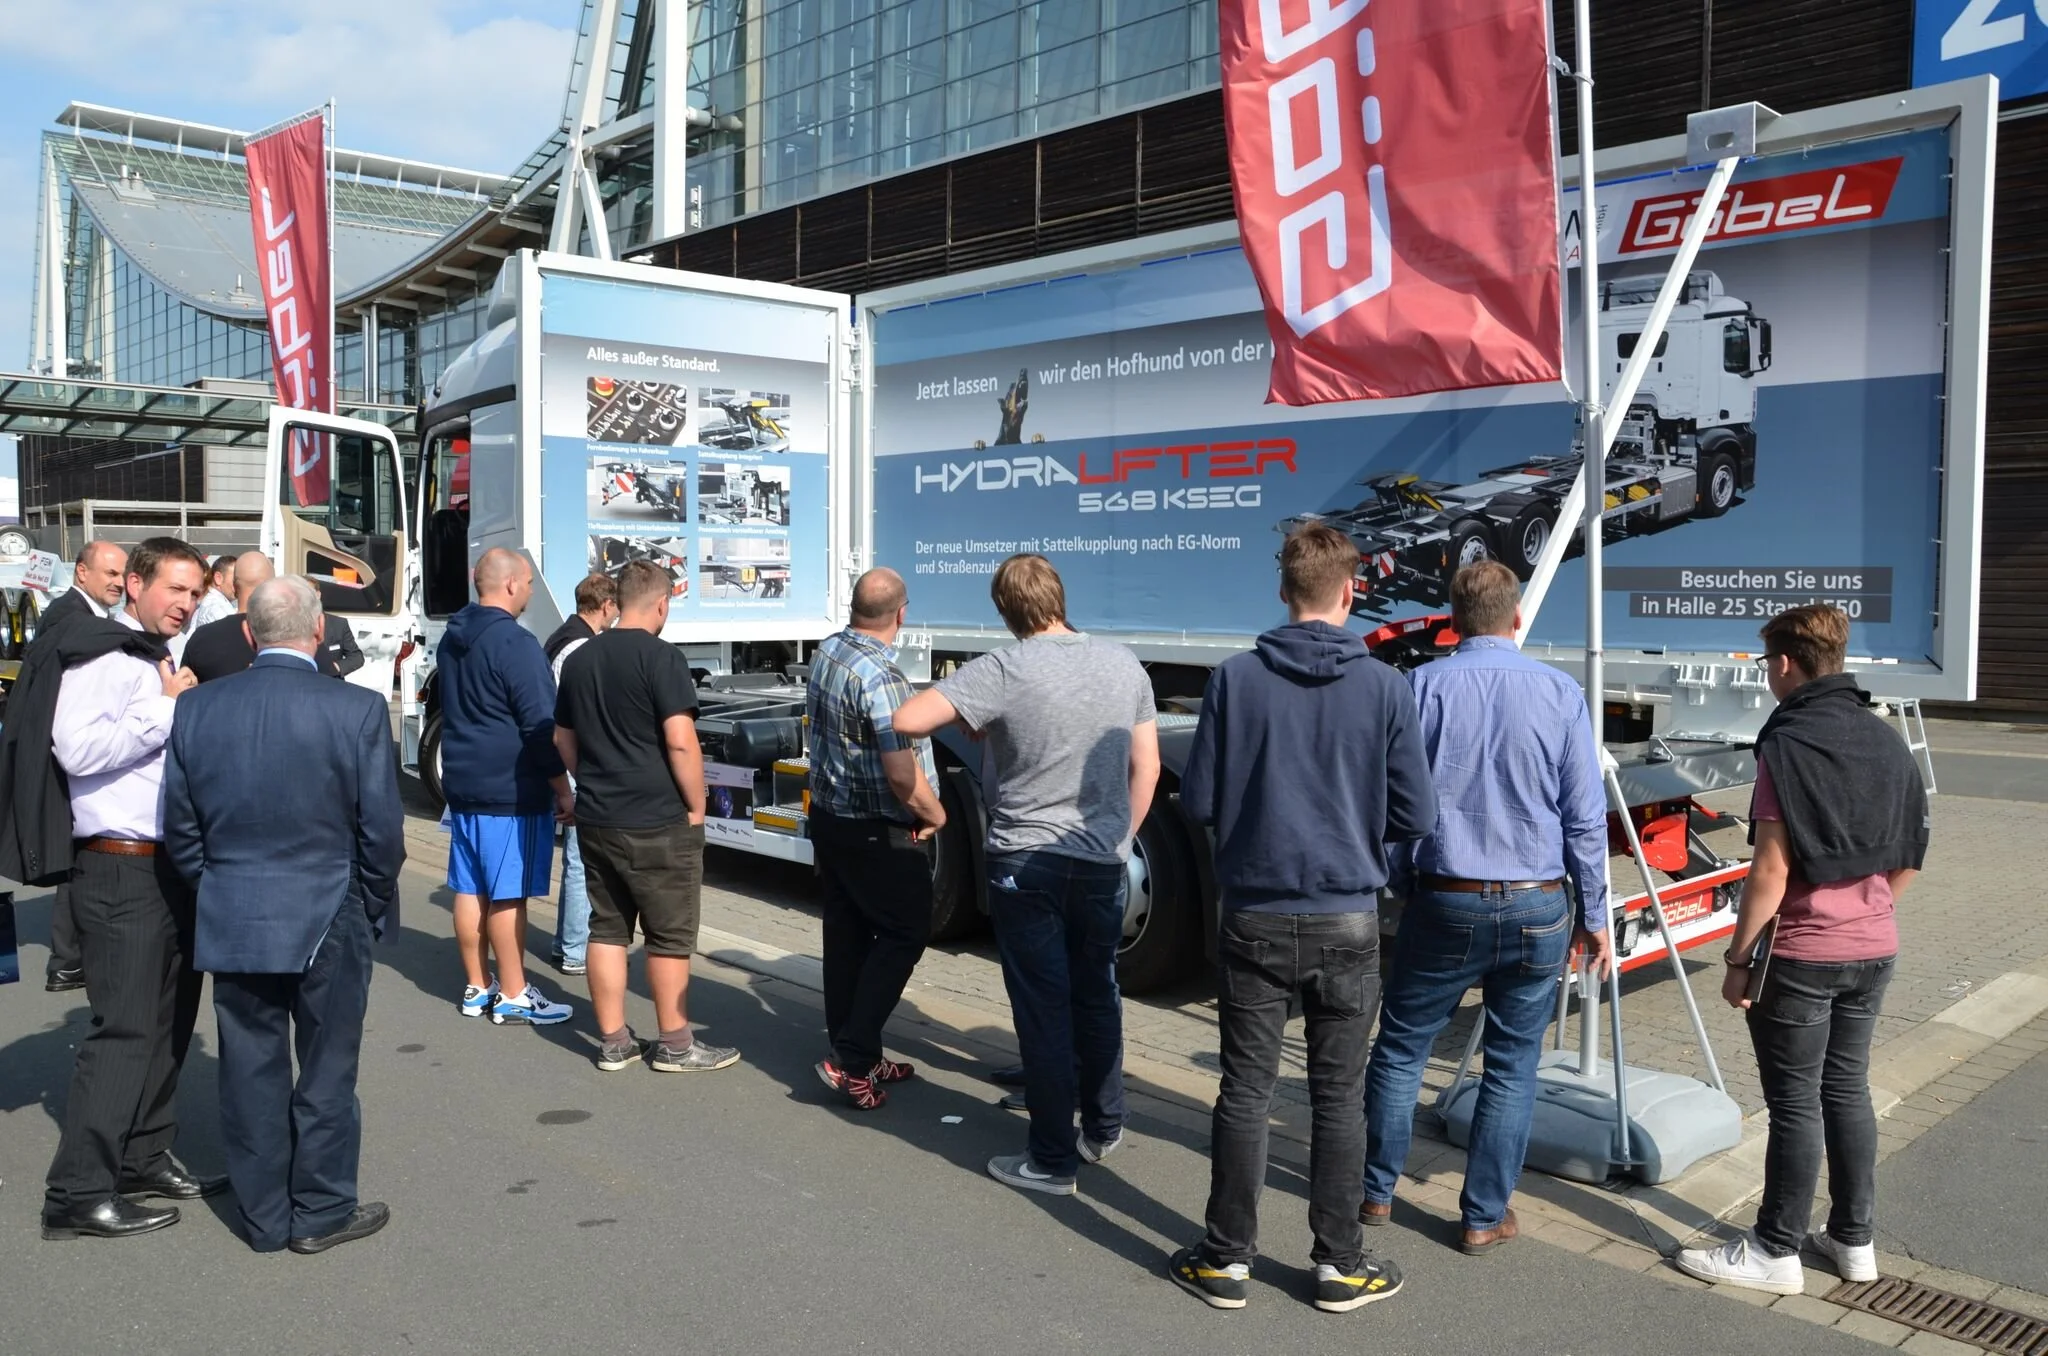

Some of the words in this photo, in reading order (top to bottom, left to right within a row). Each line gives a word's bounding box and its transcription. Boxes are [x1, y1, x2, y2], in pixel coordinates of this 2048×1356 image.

[586, 347, 619, 363] Alles
[621, 351, 659, 367] außer
[661, 354, 721, 373] Standard.
[916, 381, 950, 401] Jetzt
[953, 376, 998, 396] lassen
[1038, 363, 1066, 385] wir
[1070, 360, 1101, 382] den
[1107, 346, 1184, 378] Hofhund
[1190, 347, 1225, 368] von
[1231, 339, 1265, 363] der
[1078, 490, 1157, 513] 568
[1163, 485, 1261, 509] KSEG
[915, 541, 934, 554] Der
[936, 542, 963, 553] neue
[965, 539, 1018, 553] Umsetzer
[1020, 537, 1040, 552] mit
[1043, 536, 1138, 555] Sattelkupplung
[1142, 534, 1173, 550] nach
[1177, 534, 1241, 550] EG-Norm
[915, 560, 935, 574] und
[1681, 570, 1777, 589] Besuchen
[1784, 570, 1816, 589] Sie
[1823, 572, 1863, 590] uns
[1642, 596, 1659, 614] in
[1666, 596, 1716, 616] Halle
[1722, 598, 1746, 616] 25
